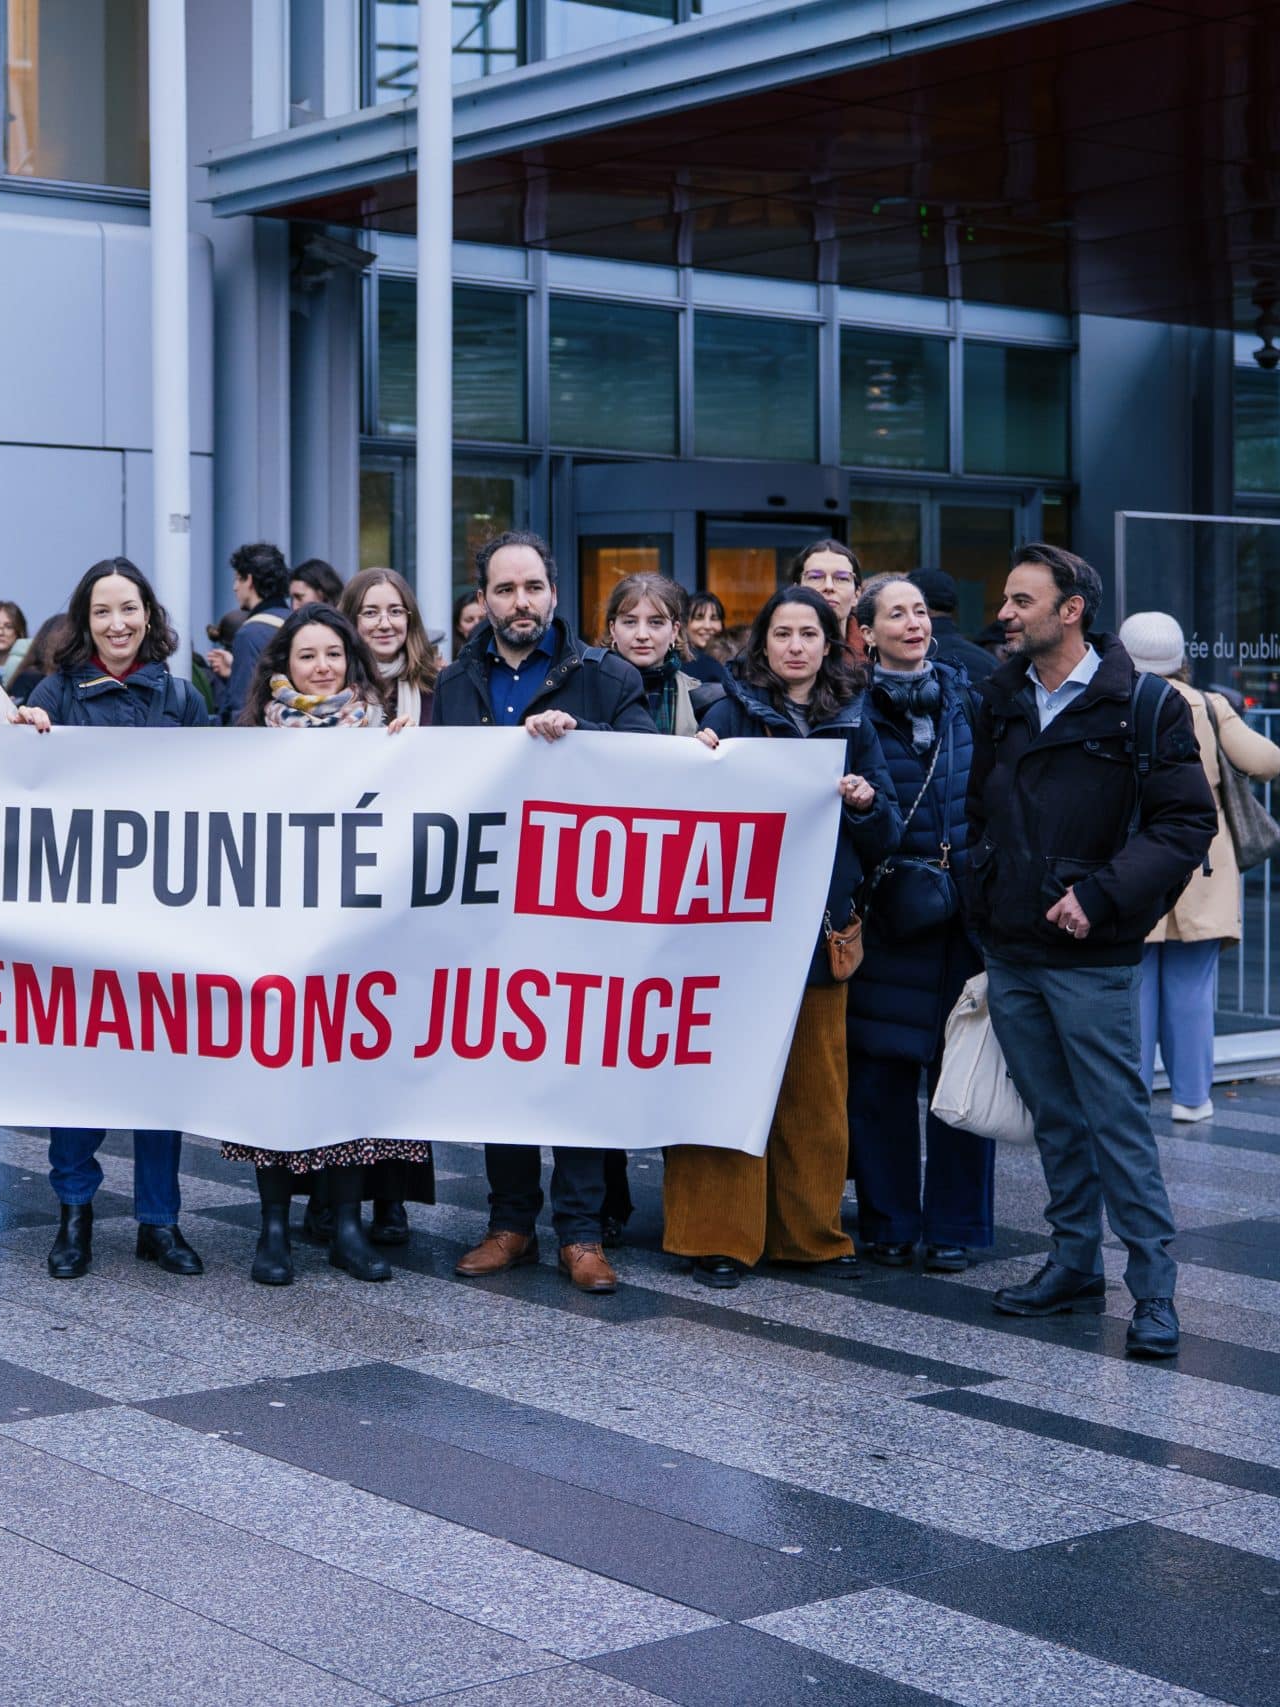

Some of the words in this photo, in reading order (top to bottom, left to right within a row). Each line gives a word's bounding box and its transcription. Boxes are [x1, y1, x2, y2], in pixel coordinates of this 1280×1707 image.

[1213, 631, 1234, 659] du
[1239, 632, 1280, 668] publi
[410, 811, 507, 908] DE
[527, 810, 768, 916] TOTAL
[413, 967, 721, 1069] JUSTICE
